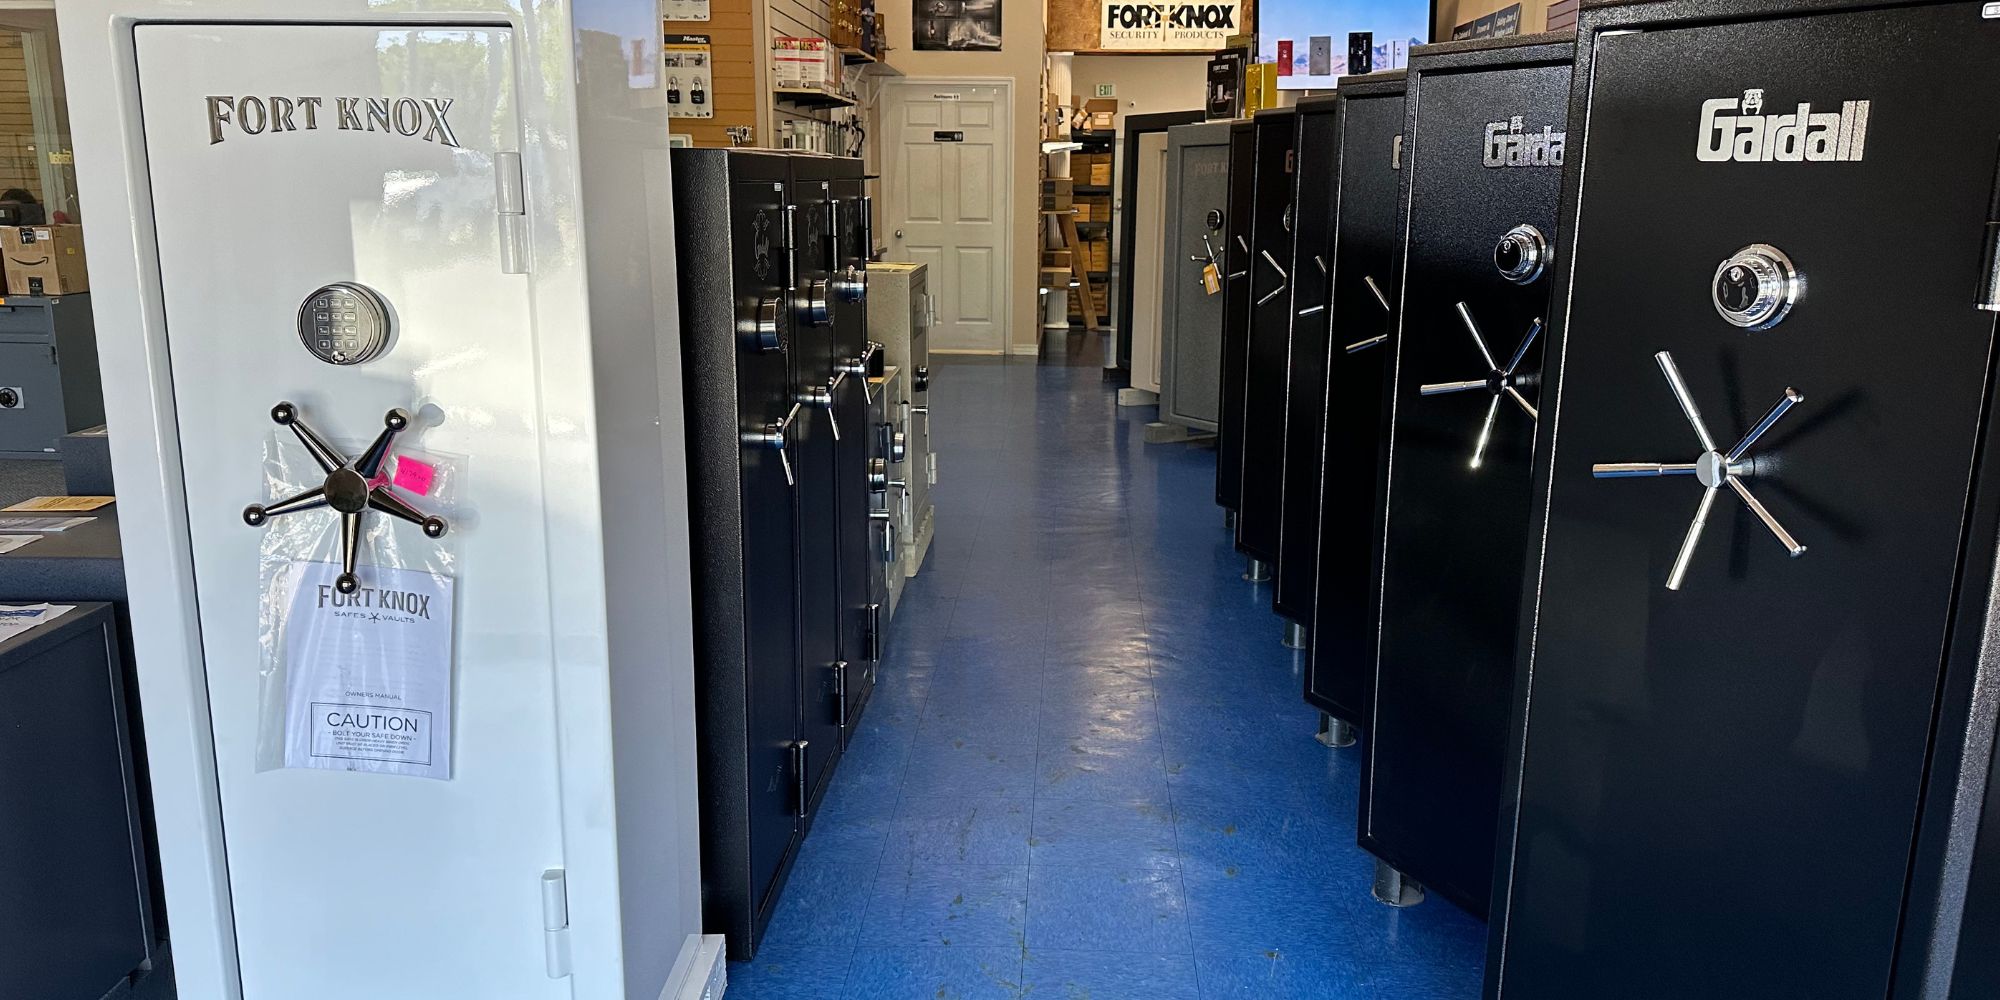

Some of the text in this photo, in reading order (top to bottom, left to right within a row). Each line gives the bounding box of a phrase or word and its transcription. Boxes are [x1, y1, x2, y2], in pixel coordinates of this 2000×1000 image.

[1108, 4, 1235, 29] FORT KNOX
[1109, 30, 1225, 39] SECURITY PRODUCTS
[1099, 84, 1112, 96] EXIT
[204, 95, 461, 148] FORT KNOX
[1696, 97, 1870, 162] Gardall
[317, 584, 431, 620] FORT KNOX
[334, 610, 415, 624] SAFES VAULTS
[375, 692, 402, 700] MANUAL
[326, 712, 418, 733] CAUTION
[352, 730, 371, 738] YOUR
[390, 733, 412, 741] DOWN
